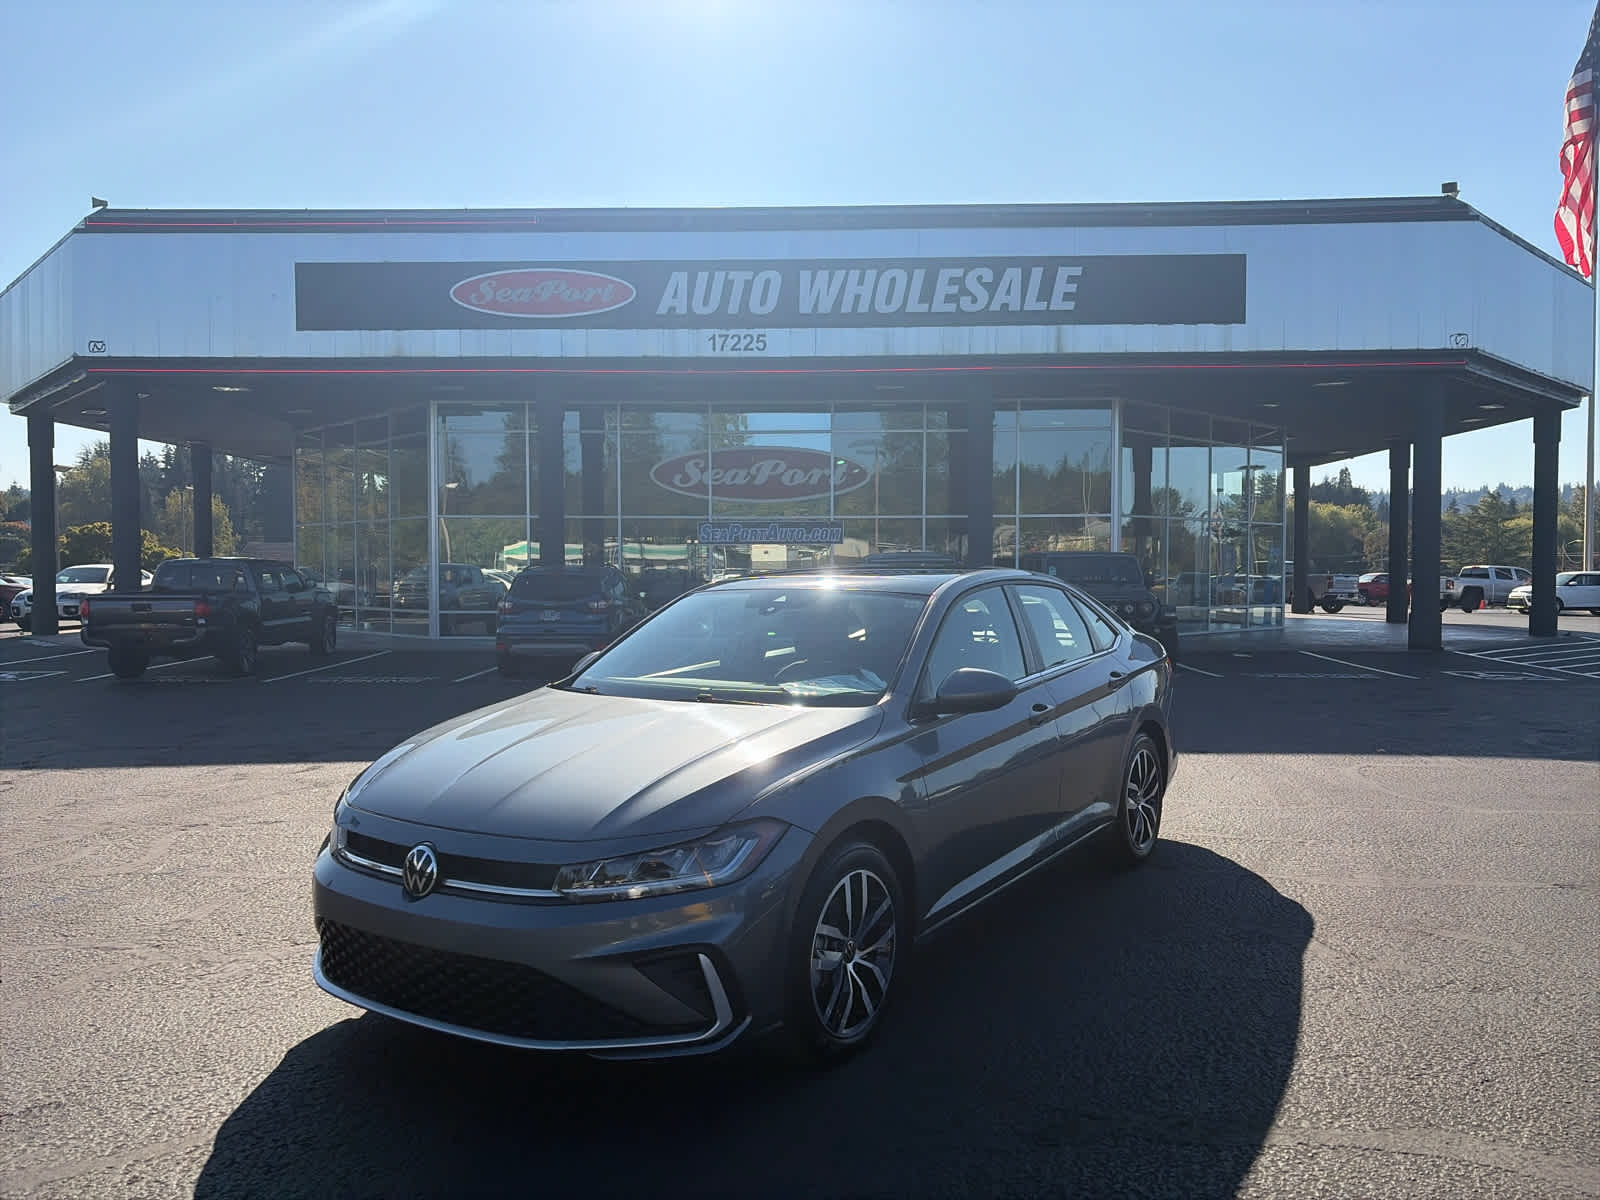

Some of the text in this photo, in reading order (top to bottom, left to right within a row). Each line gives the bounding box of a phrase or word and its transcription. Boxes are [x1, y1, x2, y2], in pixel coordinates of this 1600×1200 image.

[471, 266, 1082, 314] SeaPort AUTO WHOLESALE
[708, 334, 766, 351] 17225
[673, 459, 847, 487] SeaPort
